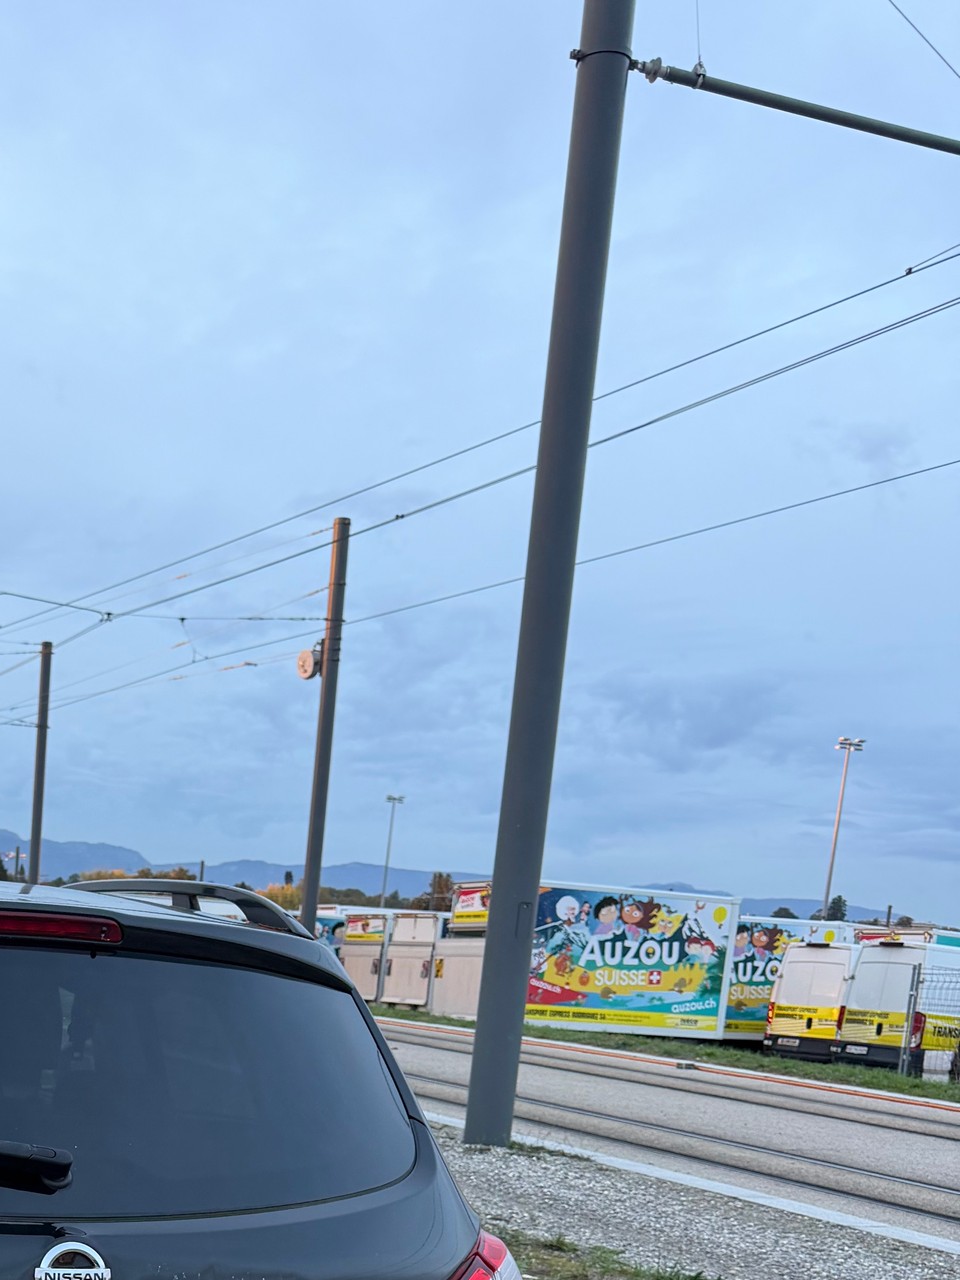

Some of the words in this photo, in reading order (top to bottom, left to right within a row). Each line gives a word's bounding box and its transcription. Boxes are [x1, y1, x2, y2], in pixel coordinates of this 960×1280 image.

[578, 940, 680, 967] AUZOU
[595, 969, 646, 987] SUISSE
[730, 985, 772, 999] SUISSE
[671, 997, 717, 1013] auzou.ch
